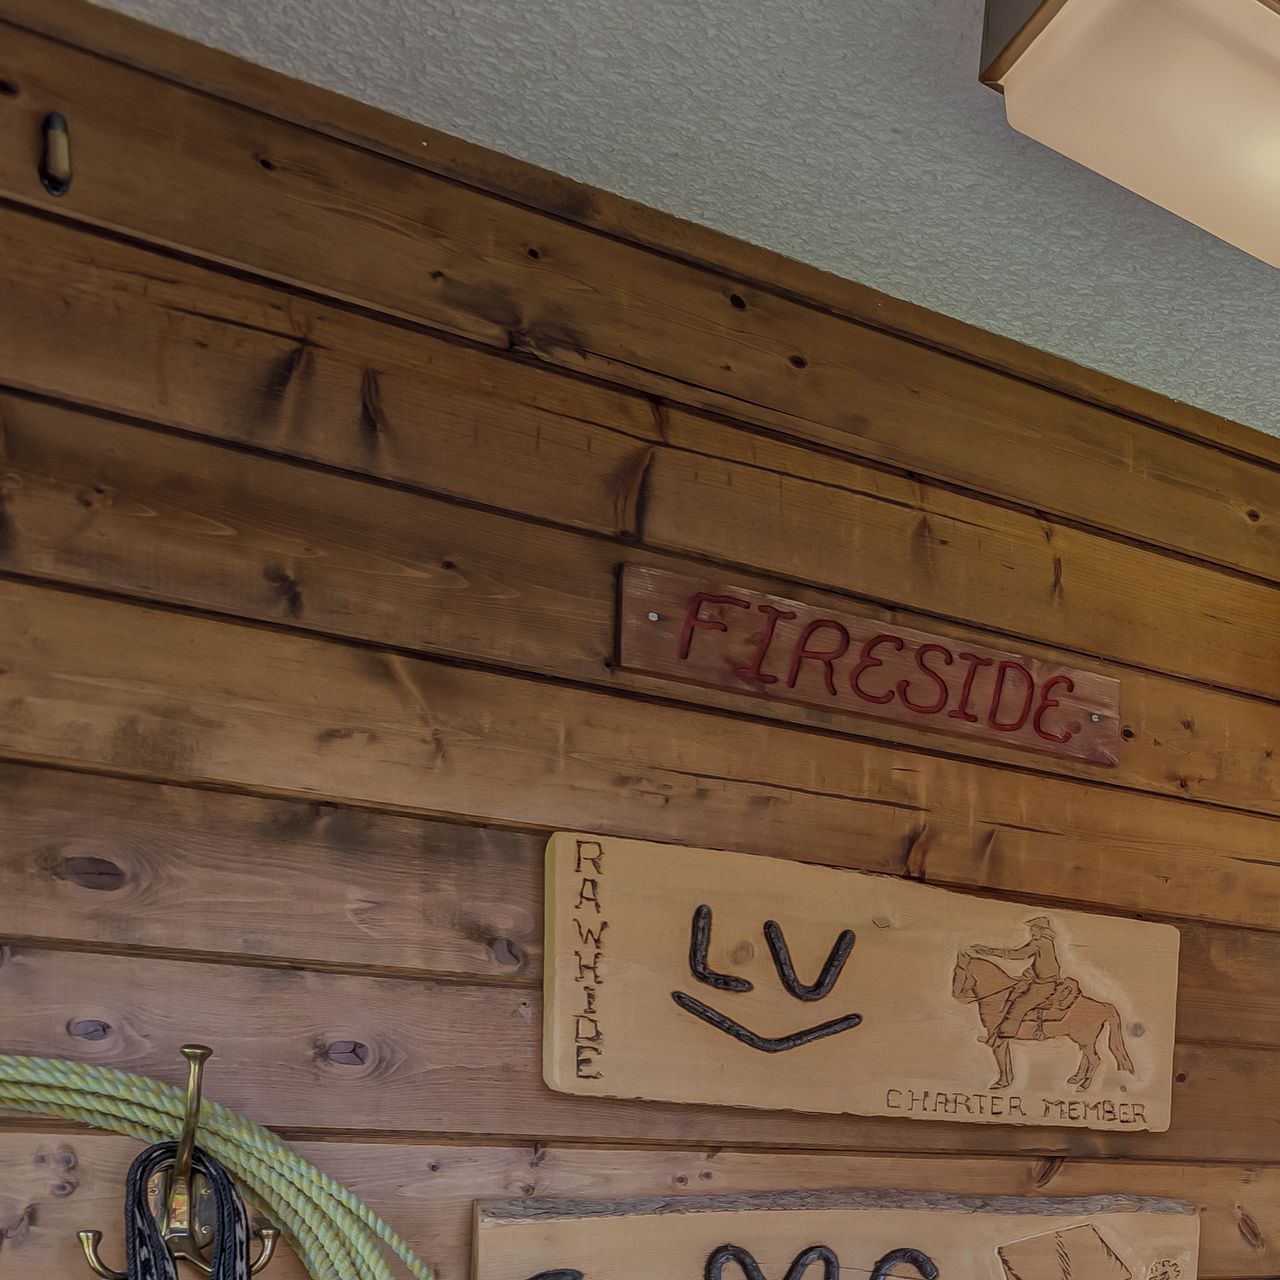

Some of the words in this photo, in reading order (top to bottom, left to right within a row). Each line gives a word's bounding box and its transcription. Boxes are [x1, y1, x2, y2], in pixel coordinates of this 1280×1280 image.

[678, 593, 1075, 744] FIRESIDE
[573, 838, 610, 1081] RAWHIDE
[886, 1088, 1027, 1117] CHARTER
[1041, 1098, 1148, 1124] MEMBER
